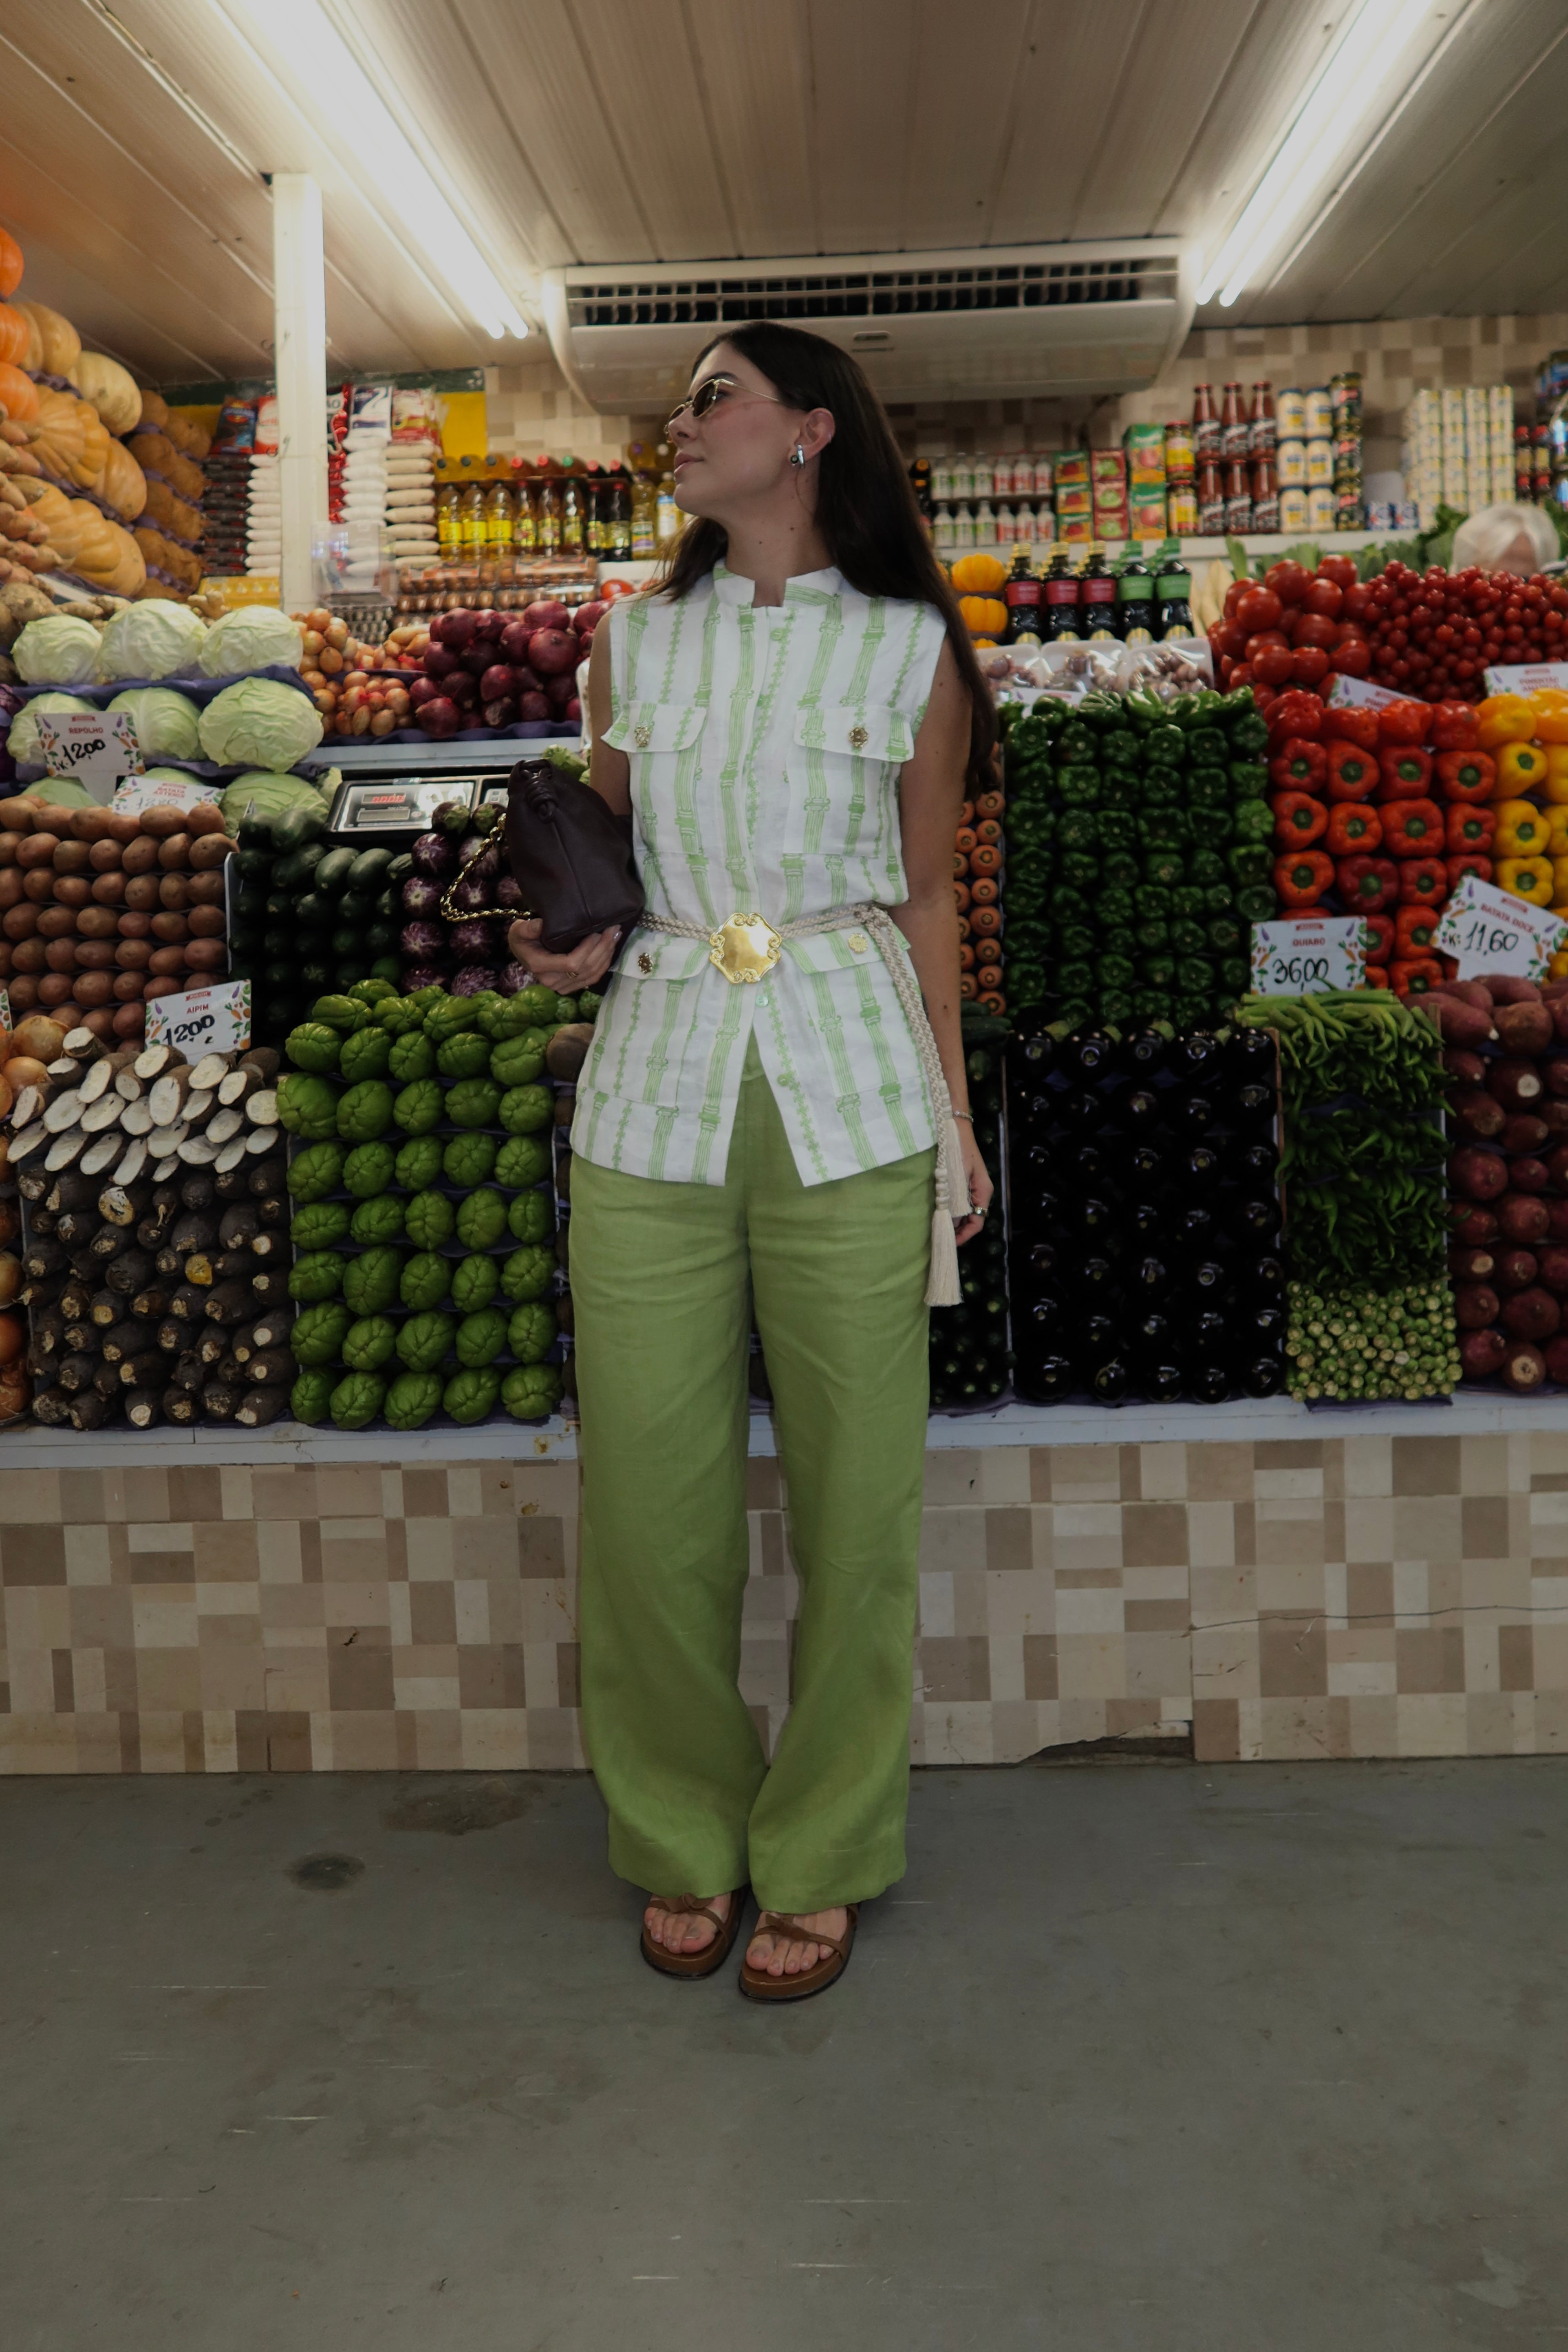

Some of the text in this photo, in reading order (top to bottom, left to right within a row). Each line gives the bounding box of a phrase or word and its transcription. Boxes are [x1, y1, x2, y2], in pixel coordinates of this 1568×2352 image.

[1481, 903, 1511, 921] BATATA
[1512, 916, 1535, 933] DOCE
[1293, 937, 1326, 947] QUIABO
[187, 1004, 209, 1014] AIPIM
